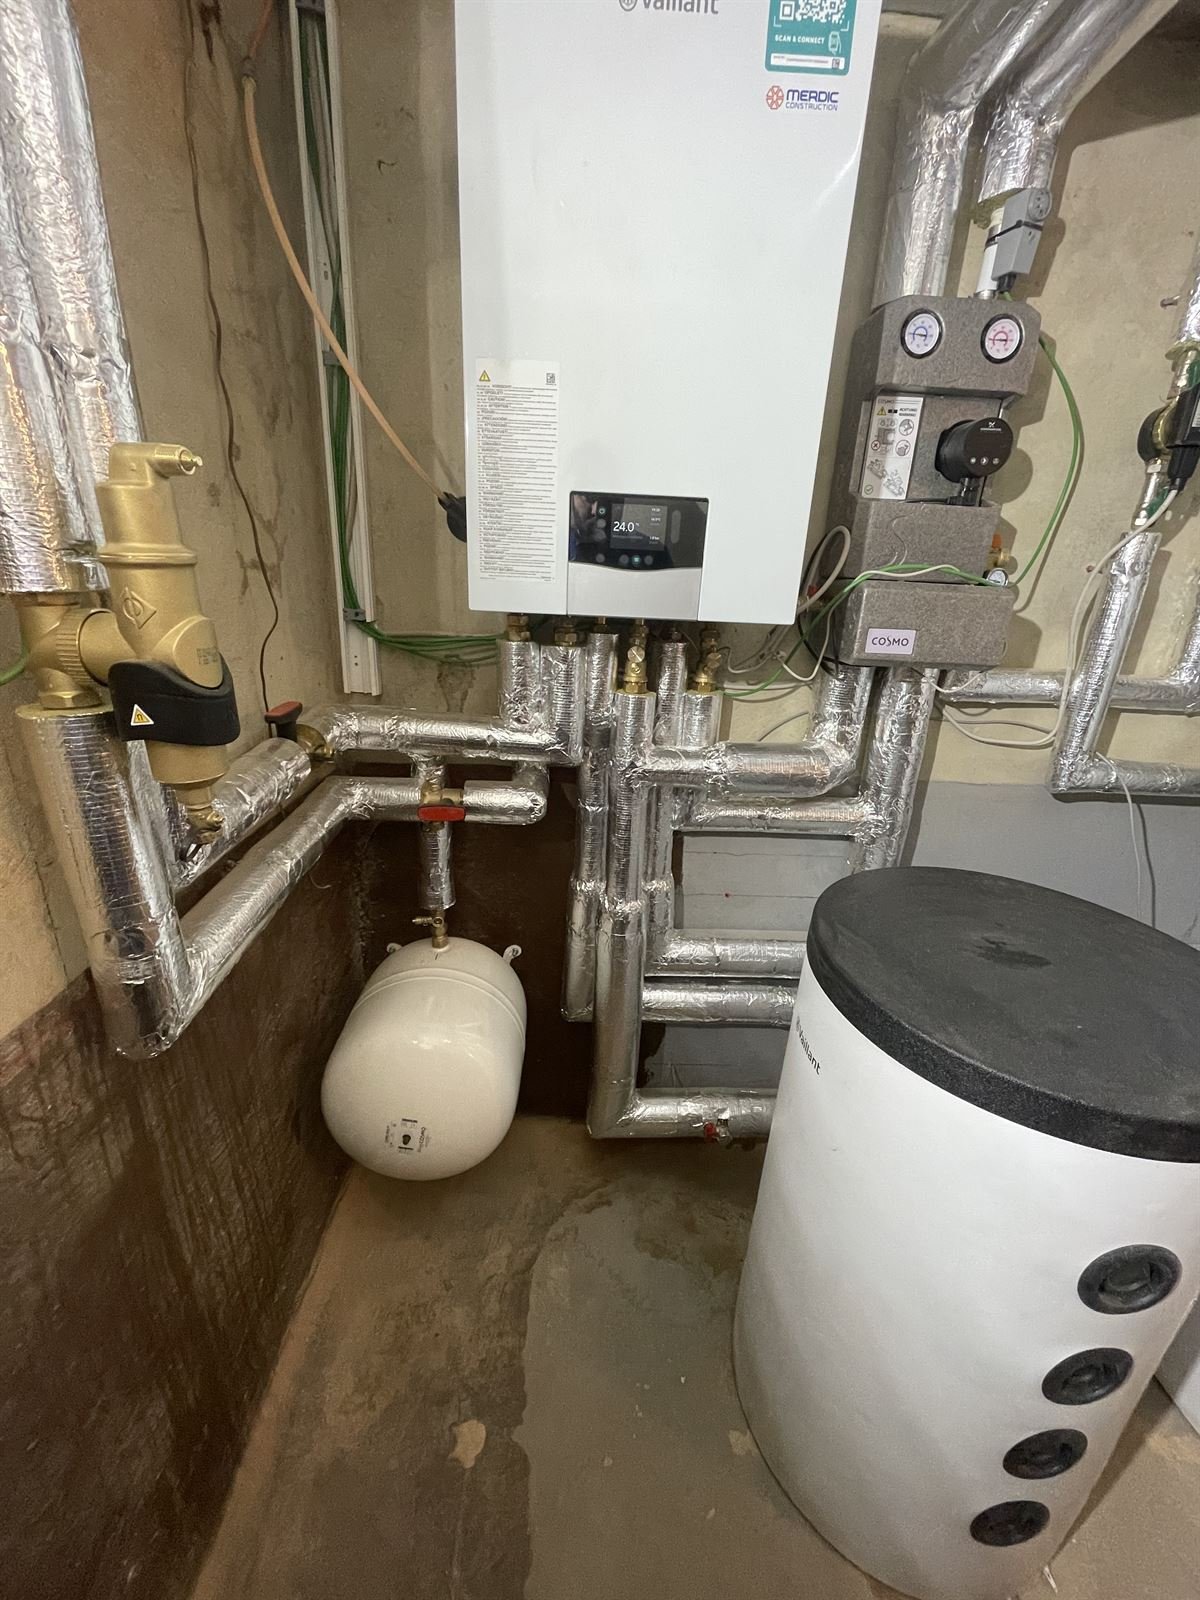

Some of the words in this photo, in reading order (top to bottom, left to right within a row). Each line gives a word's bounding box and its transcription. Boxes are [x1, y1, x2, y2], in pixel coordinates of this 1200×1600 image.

[774, 34, 792, 42] SCAN
[798, 36, 825, 45] CONNECT
[786, 89, 840, 104] MERDIC
[785, 101, 839, 112] CONSTRUCTION
[871, 636, 910, 647] COSMO
